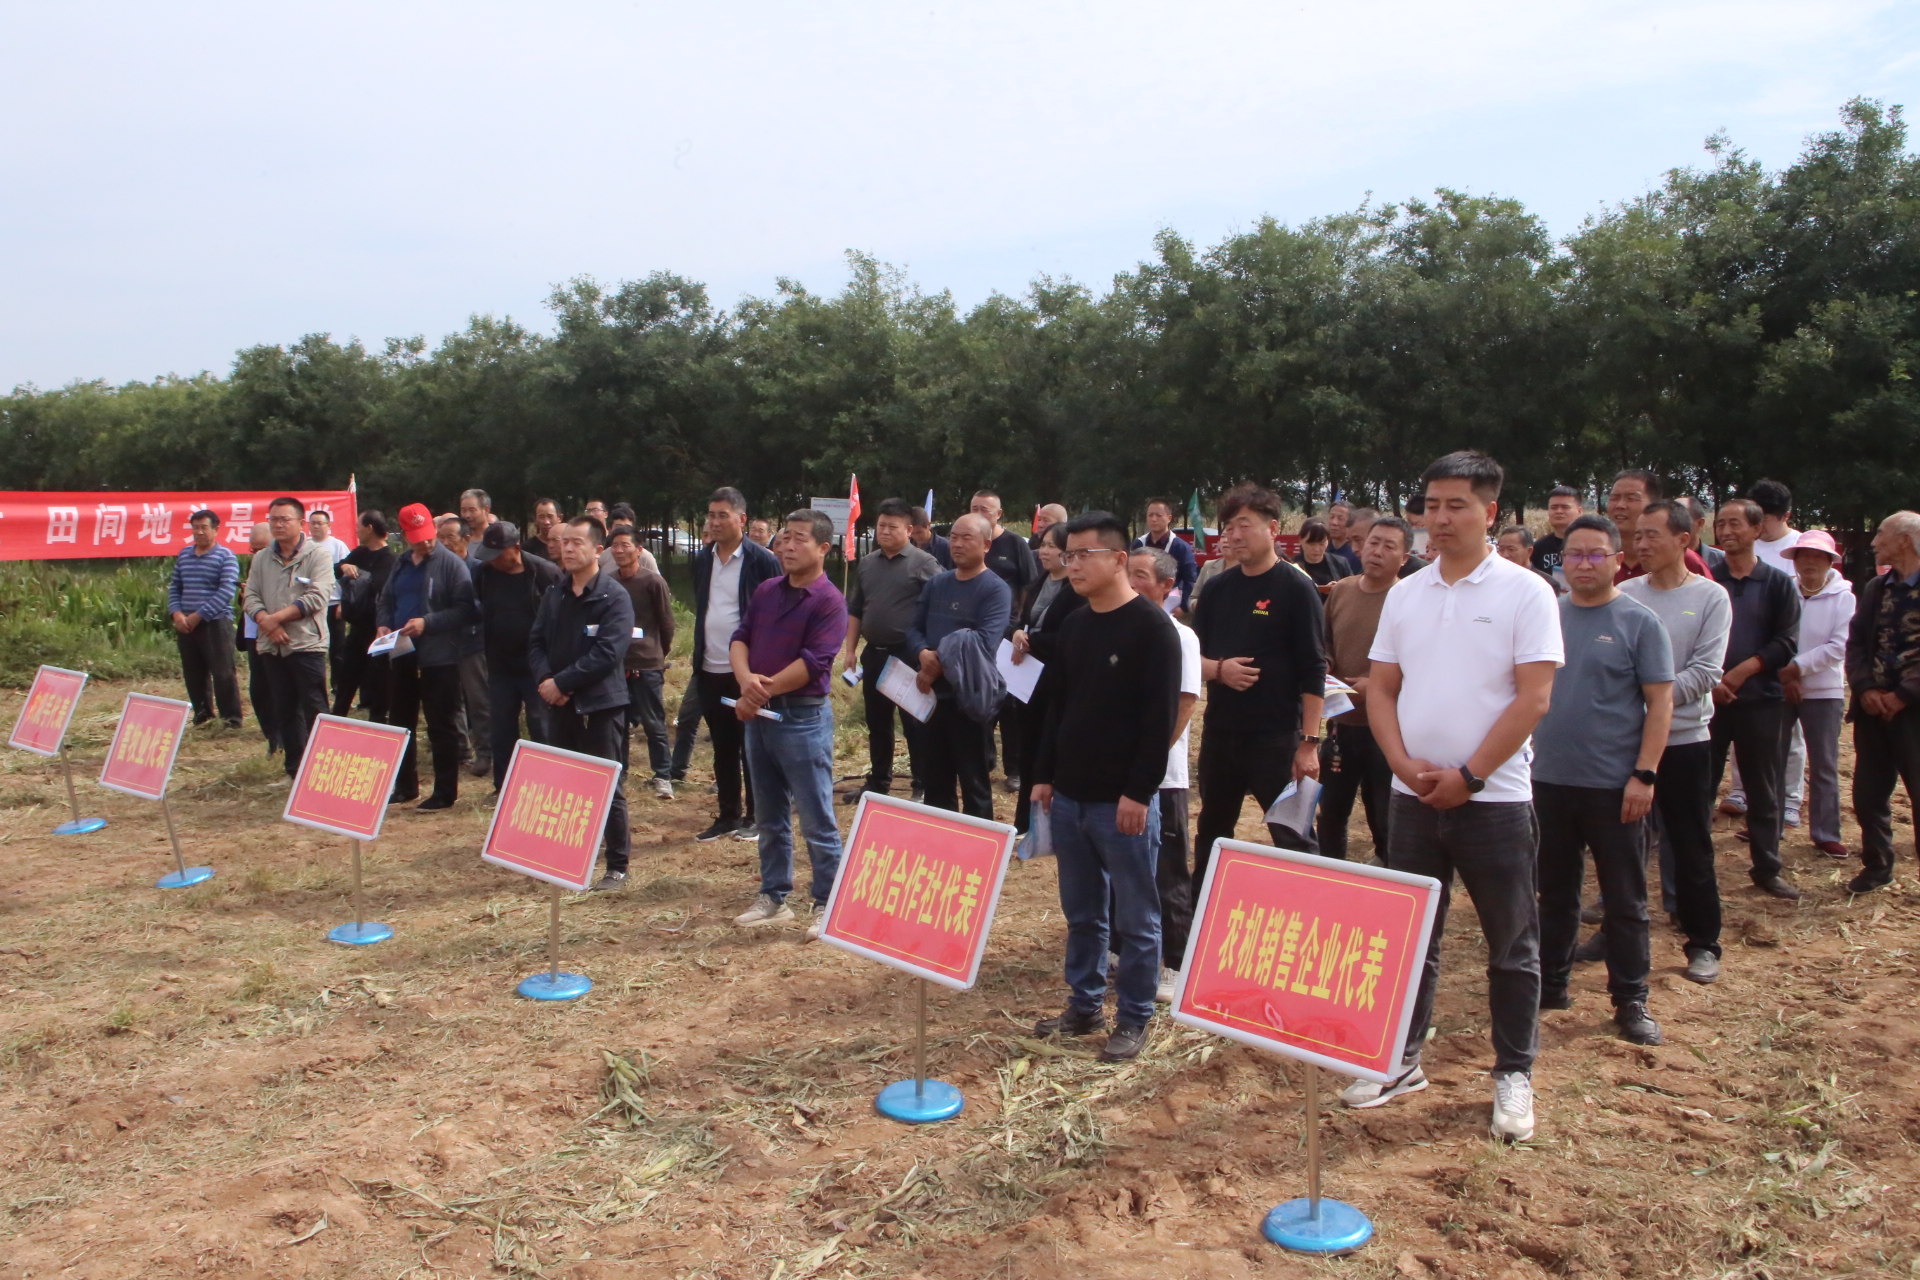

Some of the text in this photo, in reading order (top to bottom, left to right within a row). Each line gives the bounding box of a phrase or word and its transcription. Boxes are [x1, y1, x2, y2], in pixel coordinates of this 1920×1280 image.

[308, 746, 389, 807] 市县农机管理部门
[852, 841, 983, 937] 农机合作社代表
[1218, 899, 1389, 1012] 农机销售企业代表
